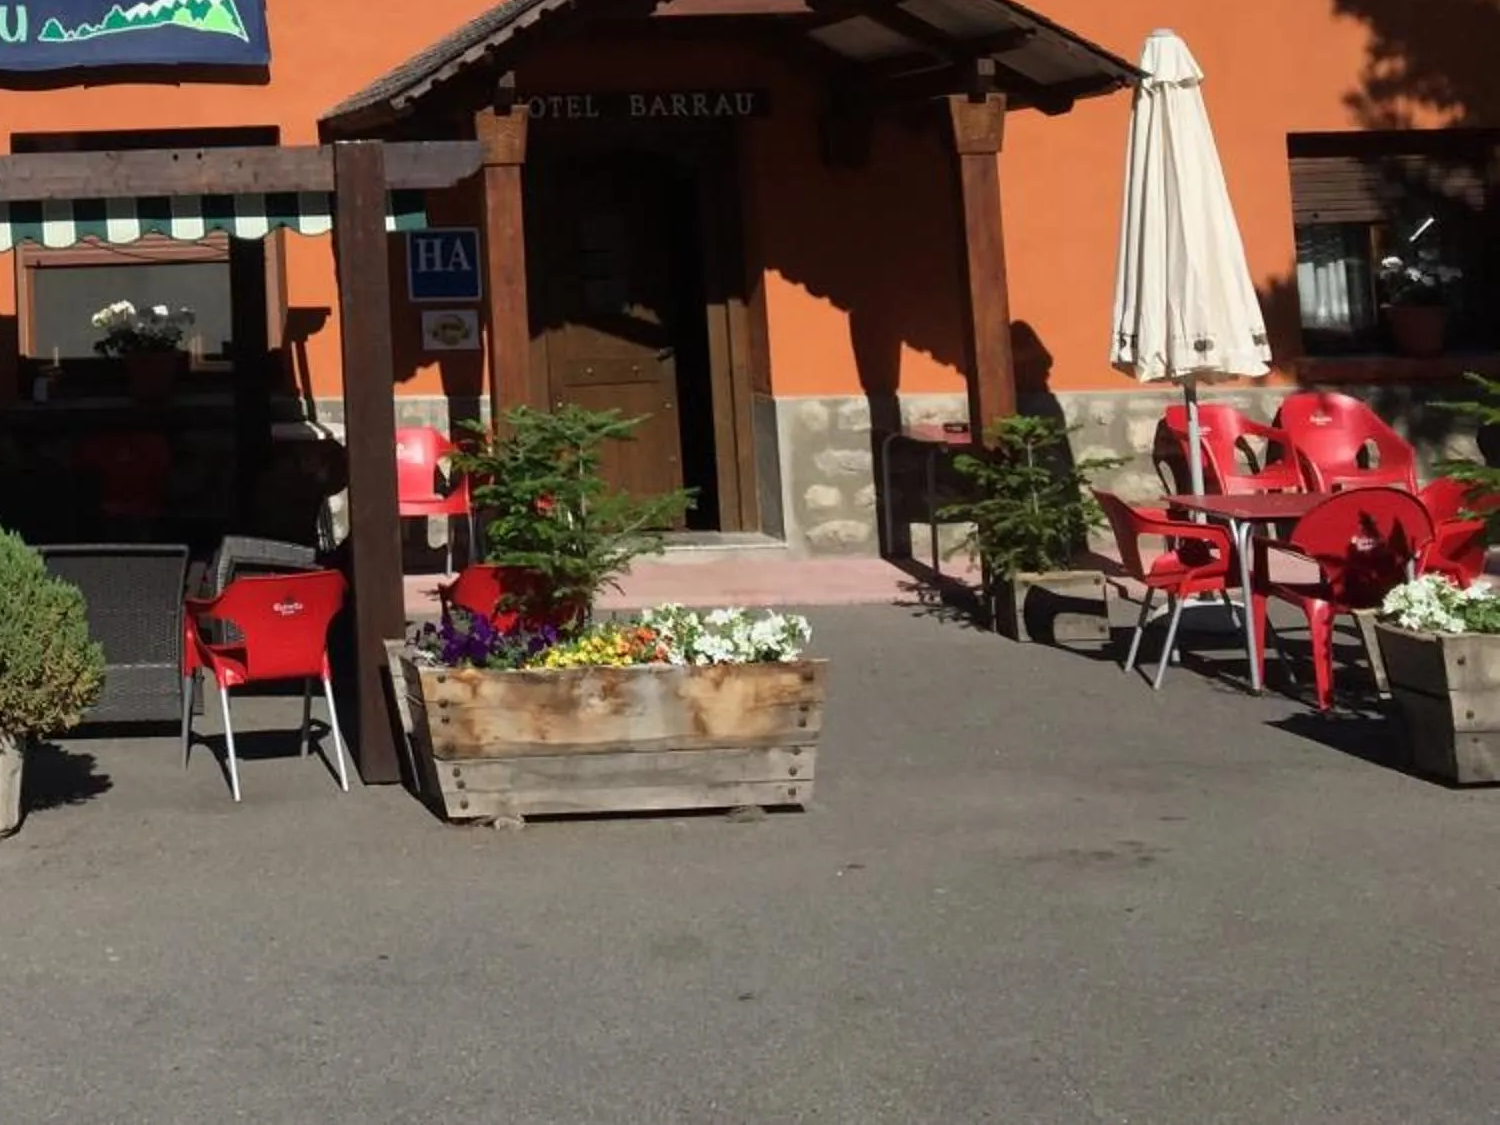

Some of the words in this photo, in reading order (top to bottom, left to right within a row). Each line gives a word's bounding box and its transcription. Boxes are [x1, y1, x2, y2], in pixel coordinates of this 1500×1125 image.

[516, 94, 600, 119] OTEL
[629, 92, 756, 117] BARRAU
[415, 236, 473, 273] HA
